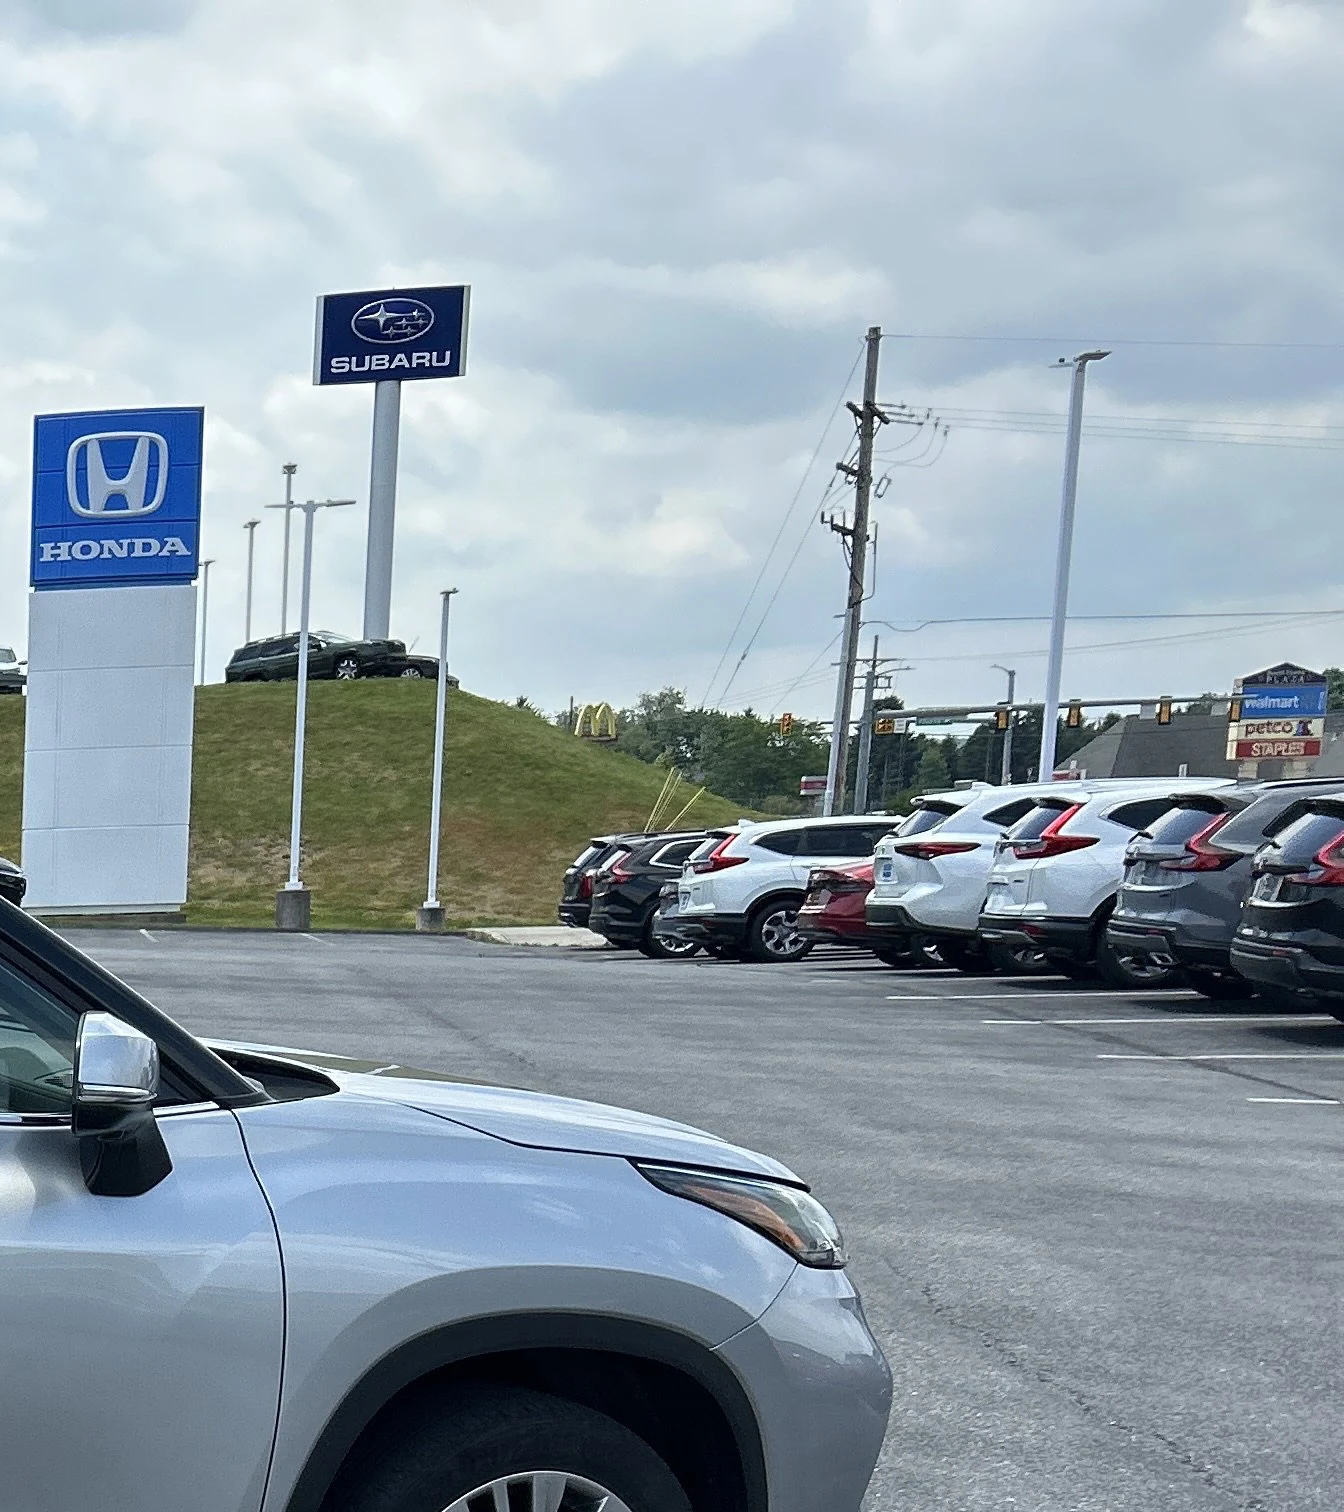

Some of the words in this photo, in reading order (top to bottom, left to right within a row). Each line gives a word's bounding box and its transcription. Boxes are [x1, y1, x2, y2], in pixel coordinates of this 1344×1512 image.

[330, 351, 451, 373] SUBARU
[39, 537, 191, 562] HONDA
[1245, 720, 1293, 737] petco
[1251, 742, 1305, 756] STAPLES
